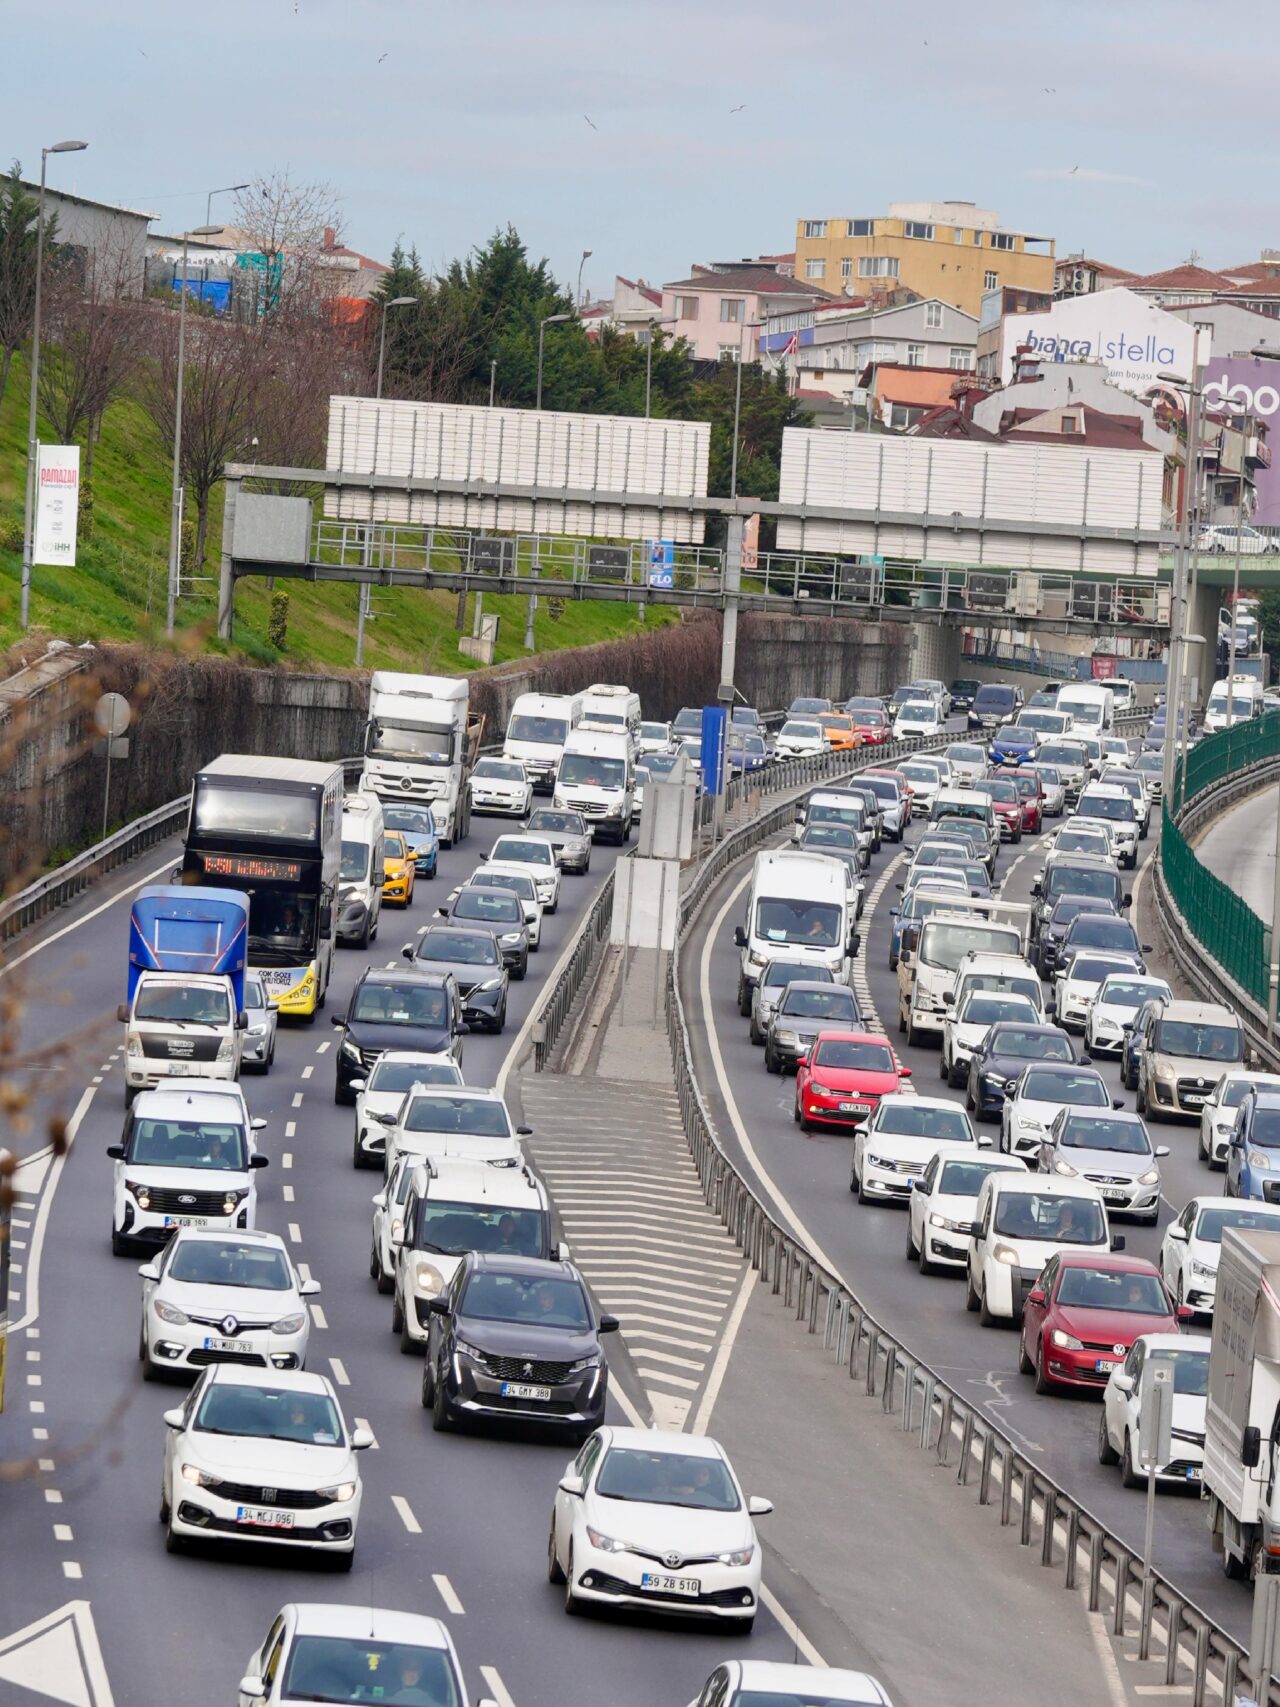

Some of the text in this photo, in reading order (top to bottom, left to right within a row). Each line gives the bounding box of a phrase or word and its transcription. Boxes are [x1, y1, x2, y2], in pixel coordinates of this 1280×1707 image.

[1026, 330, 1091, 356] bianca
[1106, 333, 1175, 365] stella
[650, 574, 672, 584] FLO
[243, 1509, 292, 1525] 34 MCJ 096
[647, 1576, 698, 1592] 59 ZB 510
